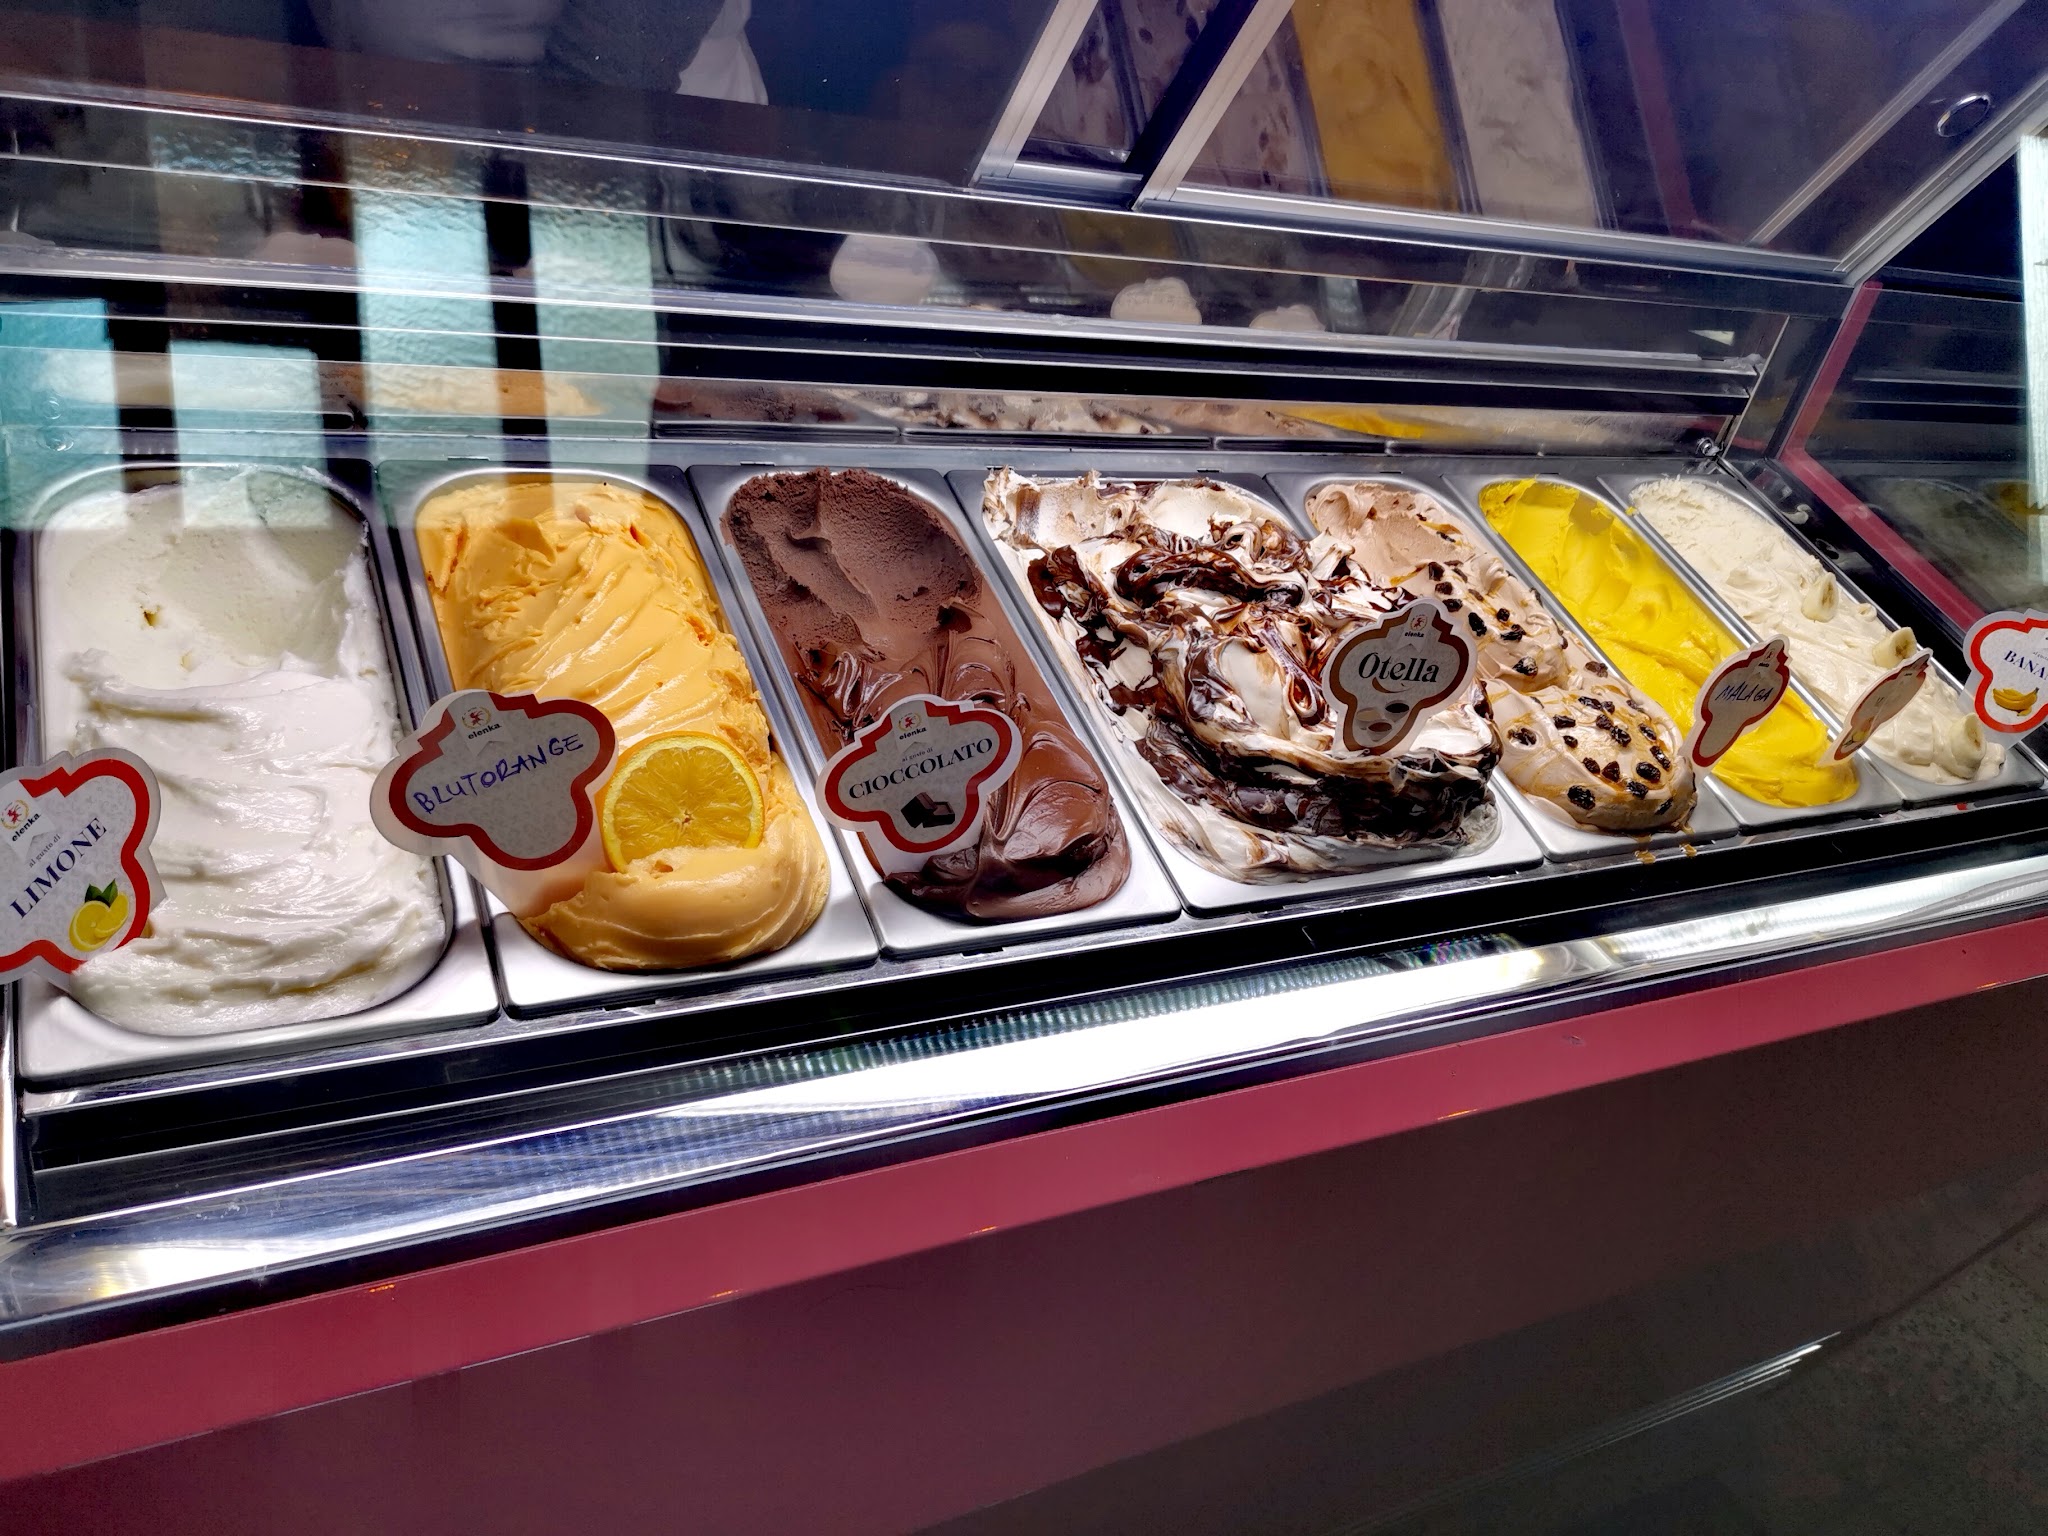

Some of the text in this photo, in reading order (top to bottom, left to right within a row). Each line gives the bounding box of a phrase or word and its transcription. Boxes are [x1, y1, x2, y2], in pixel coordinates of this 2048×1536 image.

[1358, 652, 1440, 683] Otella
[1714, 681, 1775, 702] MALAGA
[468, 722, 502, 740] elenka
[899, 727, 927, 740] elenka
[412, 733, 584, 814] BLUTORANGE
[849, 738, 993, 799] CIOCCOLATO
[12, 813, 41, 842] elenka
[9, 817, 107, 919] LIMONE
